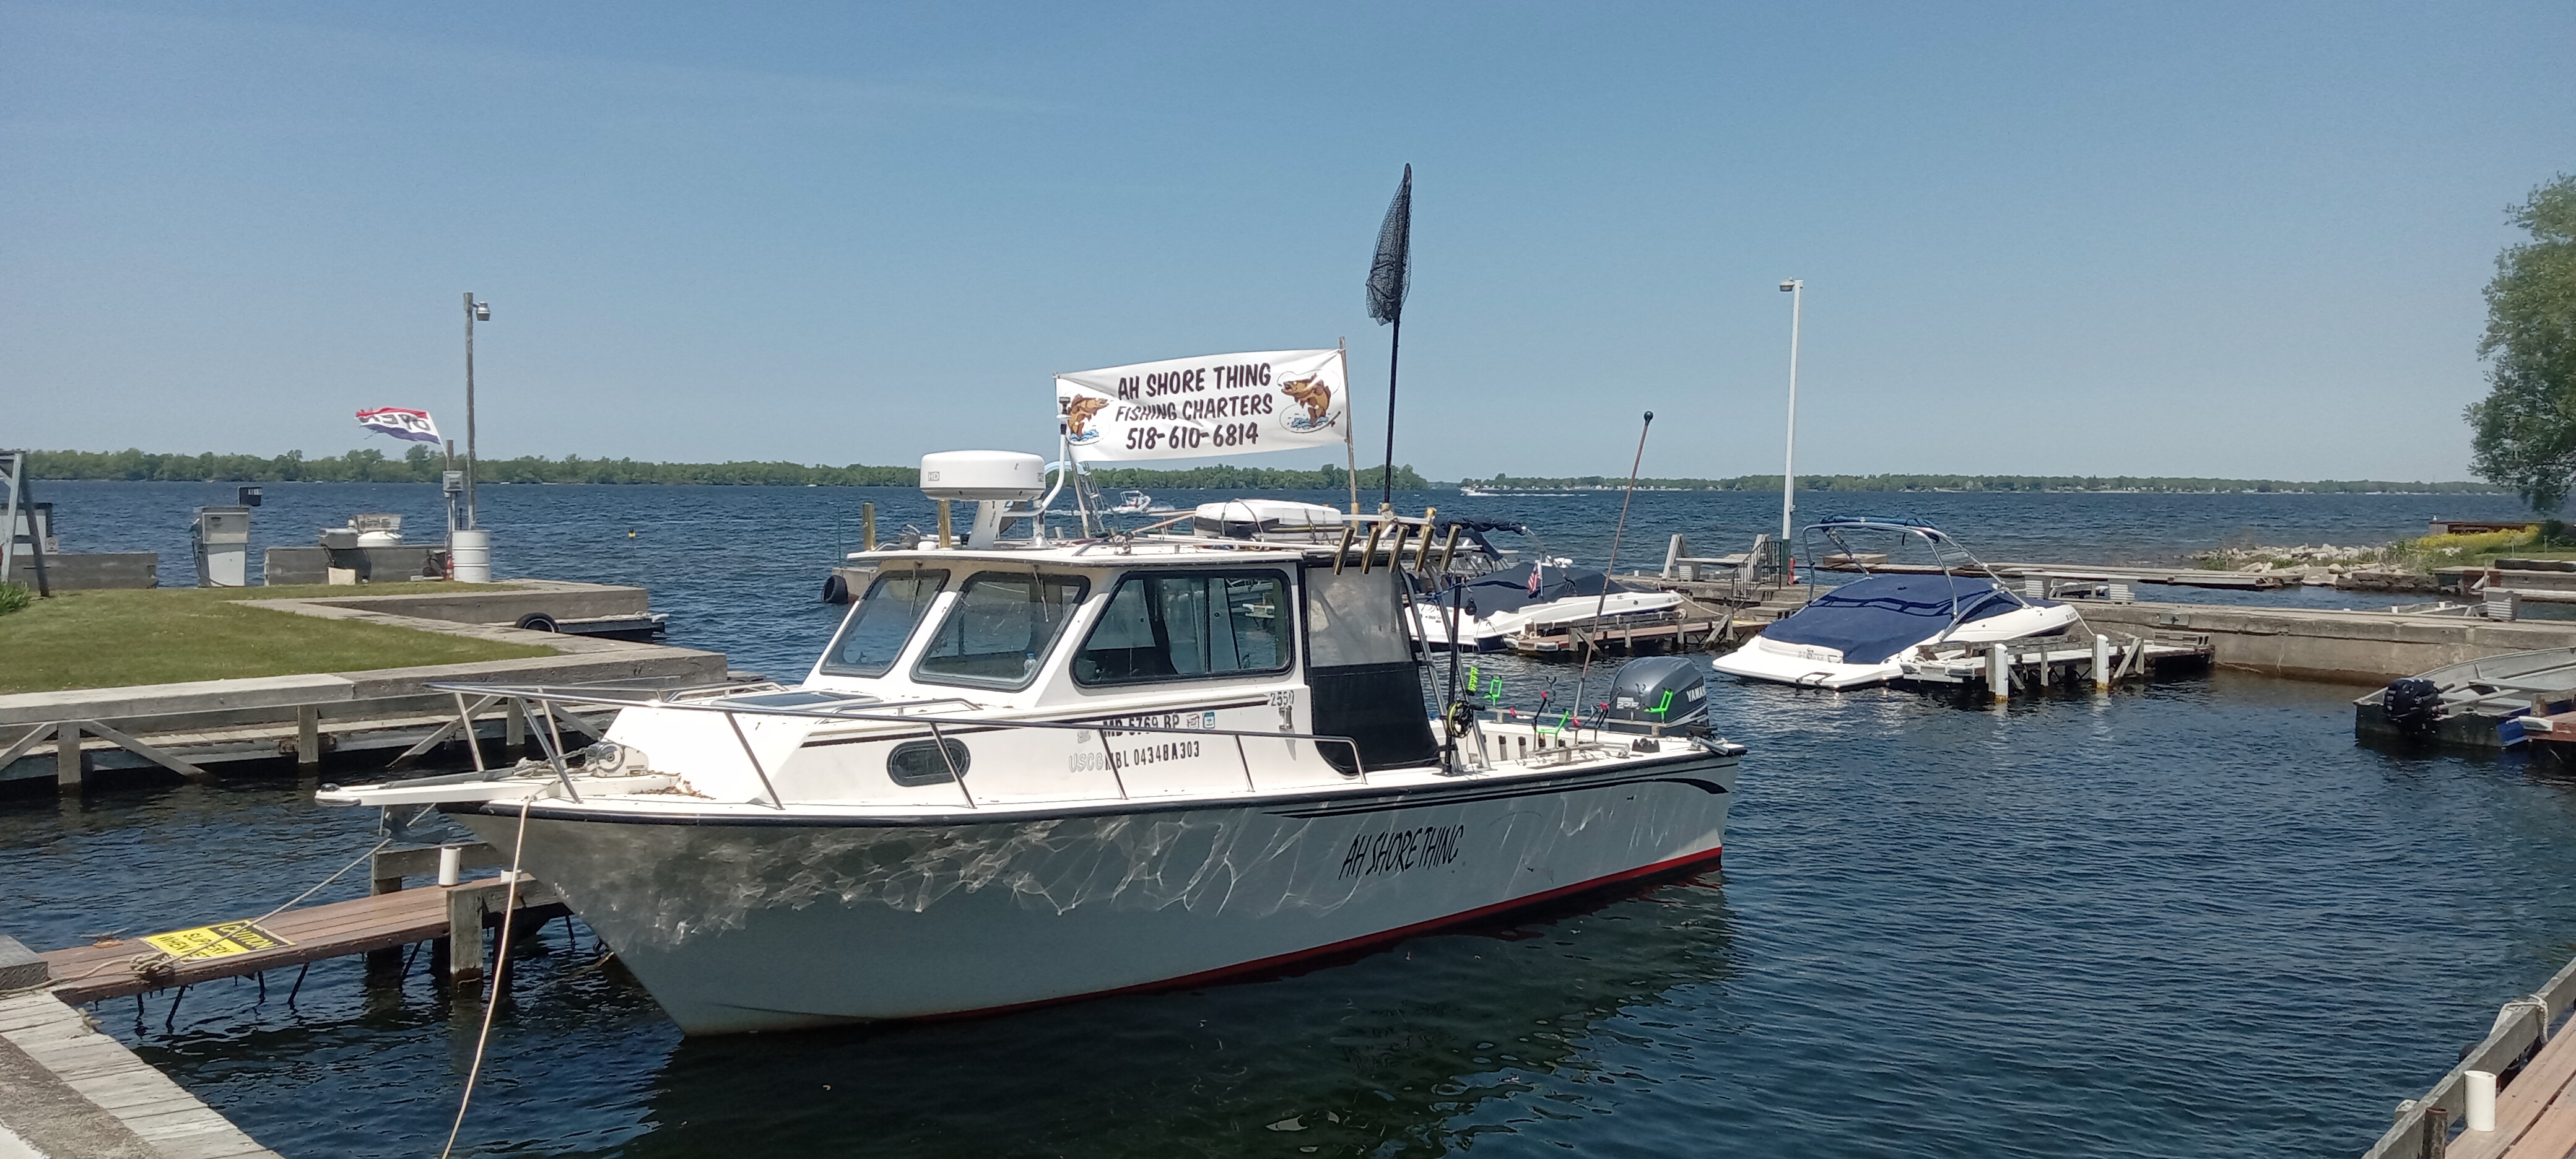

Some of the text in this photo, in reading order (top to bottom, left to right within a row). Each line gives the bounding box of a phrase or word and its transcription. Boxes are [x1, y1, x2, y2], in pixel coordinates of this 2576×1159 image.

[1118, 362, 1271, 401] AH SHORE THING
[1115, 393, 1273, 422] FISHING CHARTERS
[1125, 422, 1259, 450] 518-610-6814
[928, 472, 939, 481] HD
[1129, 716, 1159, 736] 5769
[1069, 752, 1104, 773] USCG
[1339, 825, 1464, 880] AH SHORE THING
